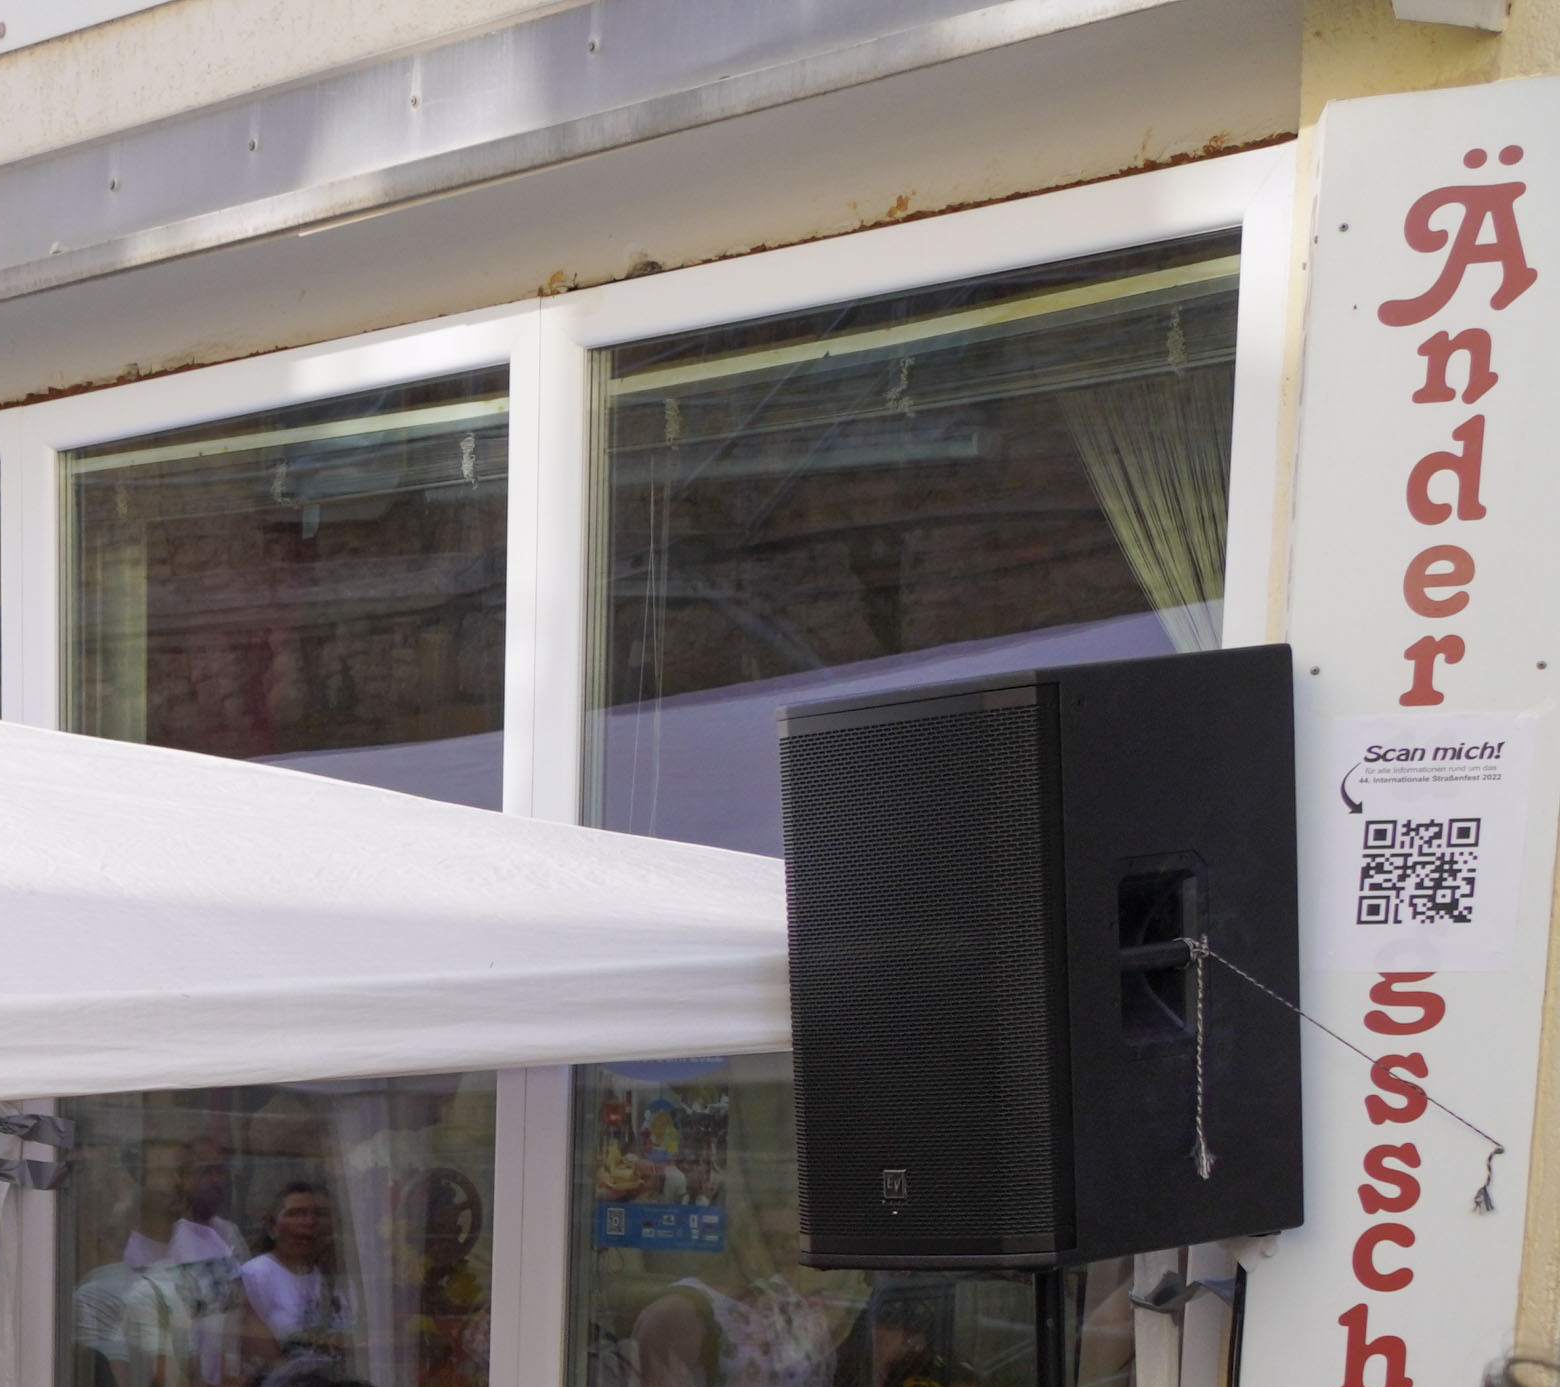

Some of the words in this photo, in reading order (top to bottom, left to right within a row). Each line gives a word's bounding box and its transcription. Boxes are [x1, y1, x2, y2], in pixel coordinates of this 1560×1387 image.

[1363, 745, 1426, 763] Scan
[1431, 741, 1506, 761] mich!
[1373, 775, 1430, 784] Internationale
[1432, 774, 1480, 783] Straßenfest
[1482, 773, 1502, 781] 2022
